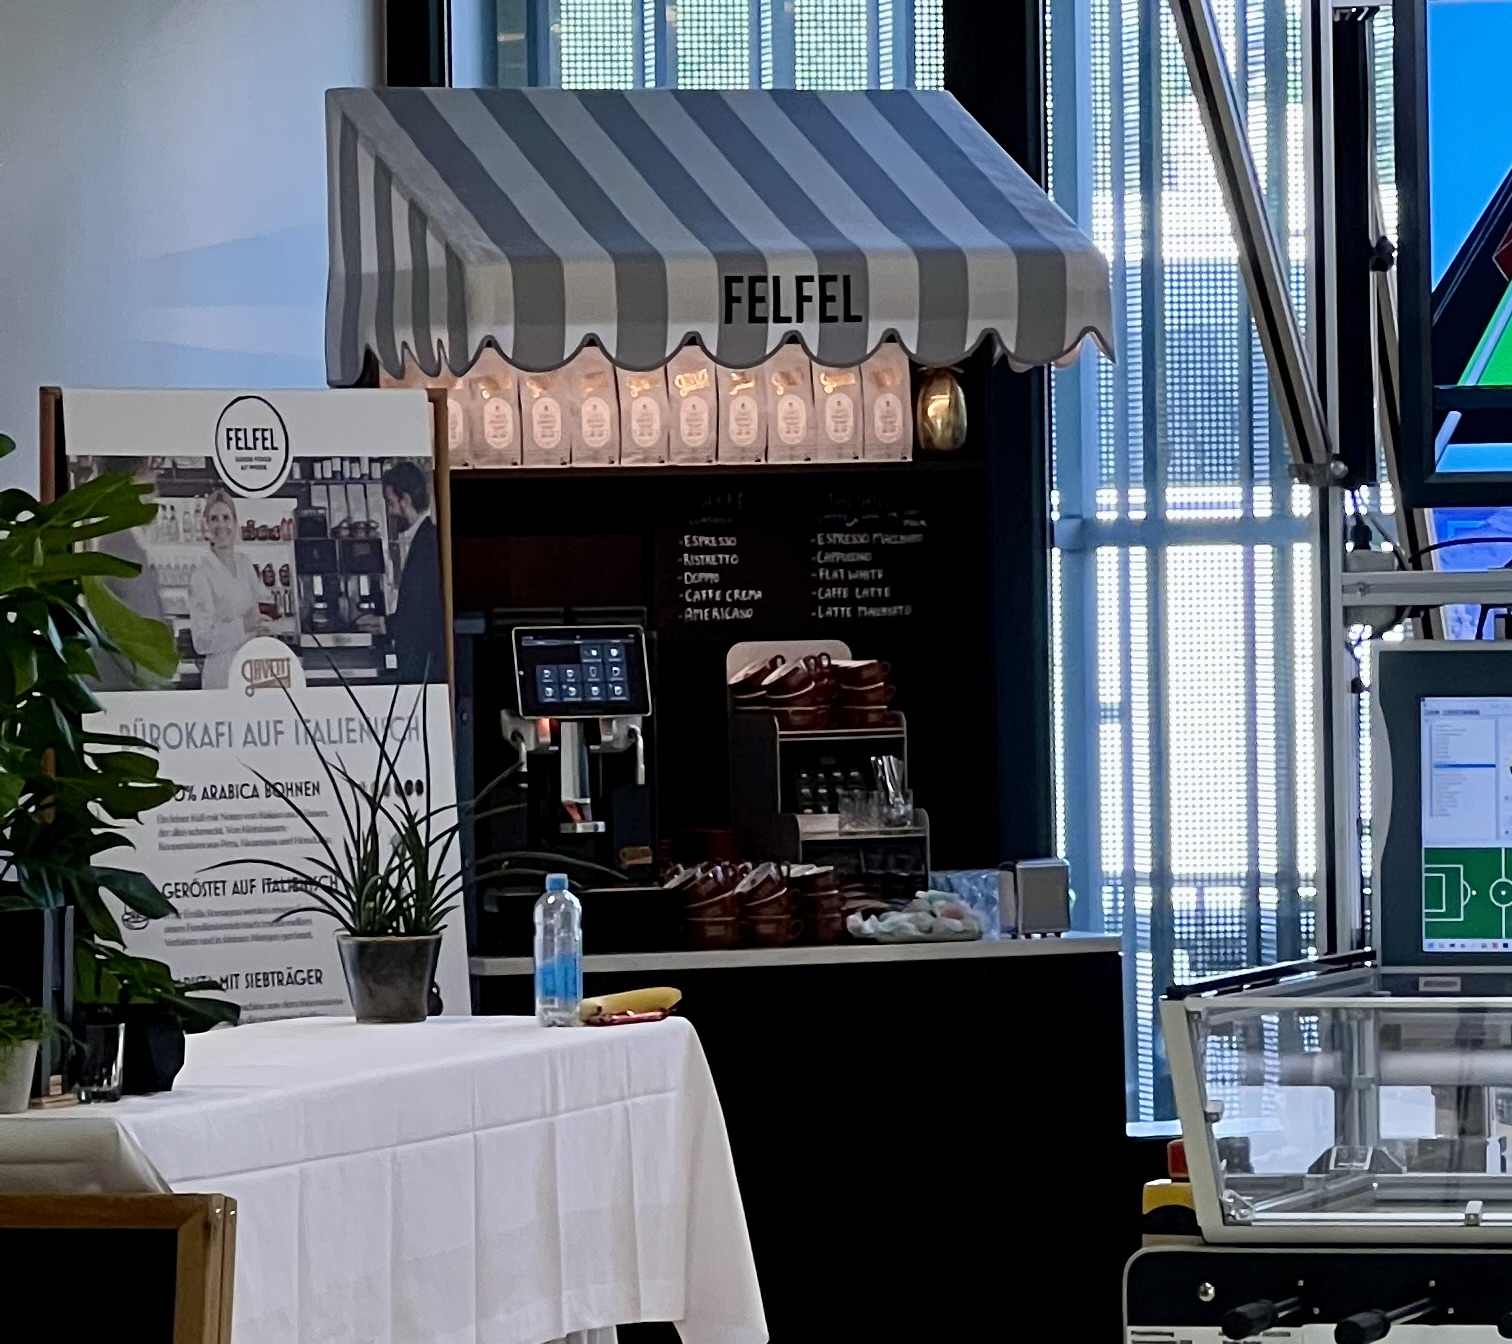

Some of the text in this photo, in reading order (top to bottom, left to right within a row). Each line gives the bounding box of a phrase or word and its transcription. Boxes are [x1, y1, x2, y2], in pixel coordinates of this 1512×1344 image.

[724, 274, 863, 324] FELFEL
[226, 427, 279, 451] FELFEL
[684, 535, 737, 547] ESPRESSO
[683, 553, 739, 566] RISTRETTO
[242, 720, 285, 748] AUF
[201, 782, 260, 801] ARABICA
[264, 780, 321, 799] BOHNEN
[161, 878, 226, 899] GERÖSTET
[231, 878, 257, 896] AUF
[245, 966, 323, 989] SIEBTRÄGER
